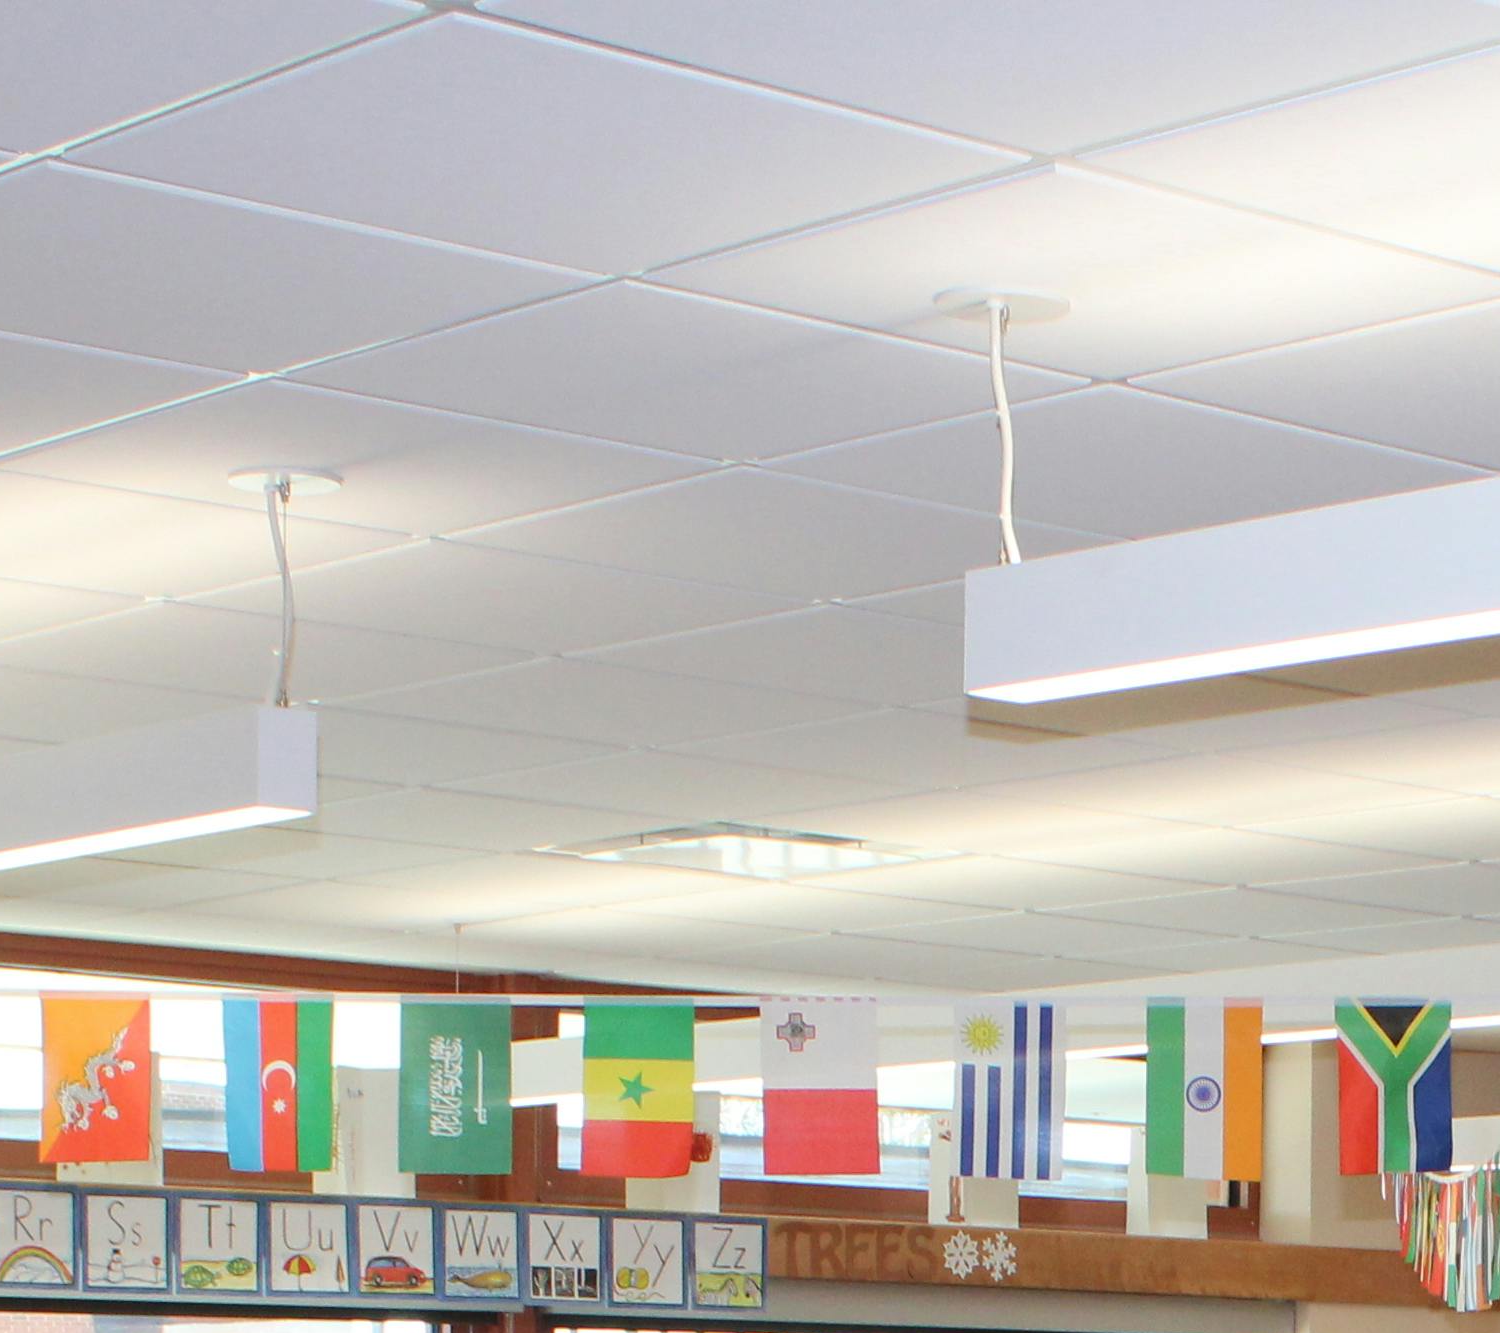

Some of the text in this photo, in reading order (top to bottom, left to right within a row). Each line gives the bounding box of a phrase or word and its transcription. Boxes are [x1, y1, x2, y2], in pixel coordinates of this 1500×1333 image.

[12, 1196, 53, 1242] Rr
[107, 1201, 143, 1246] Ss
[198, 1204, 237, 1249] Tt
[282, 1208, 335, 1252] Uu
[373, 1210, 419, 1254] Vv
[451, 1215, 510, 1258] Ww
[543, 1220, 584, 1262] Xx
[632, 1223, 675, 1288] Yy
[711, 1227, 748, 1270] Zz
[775, 1221, 935, 1284] TREES
